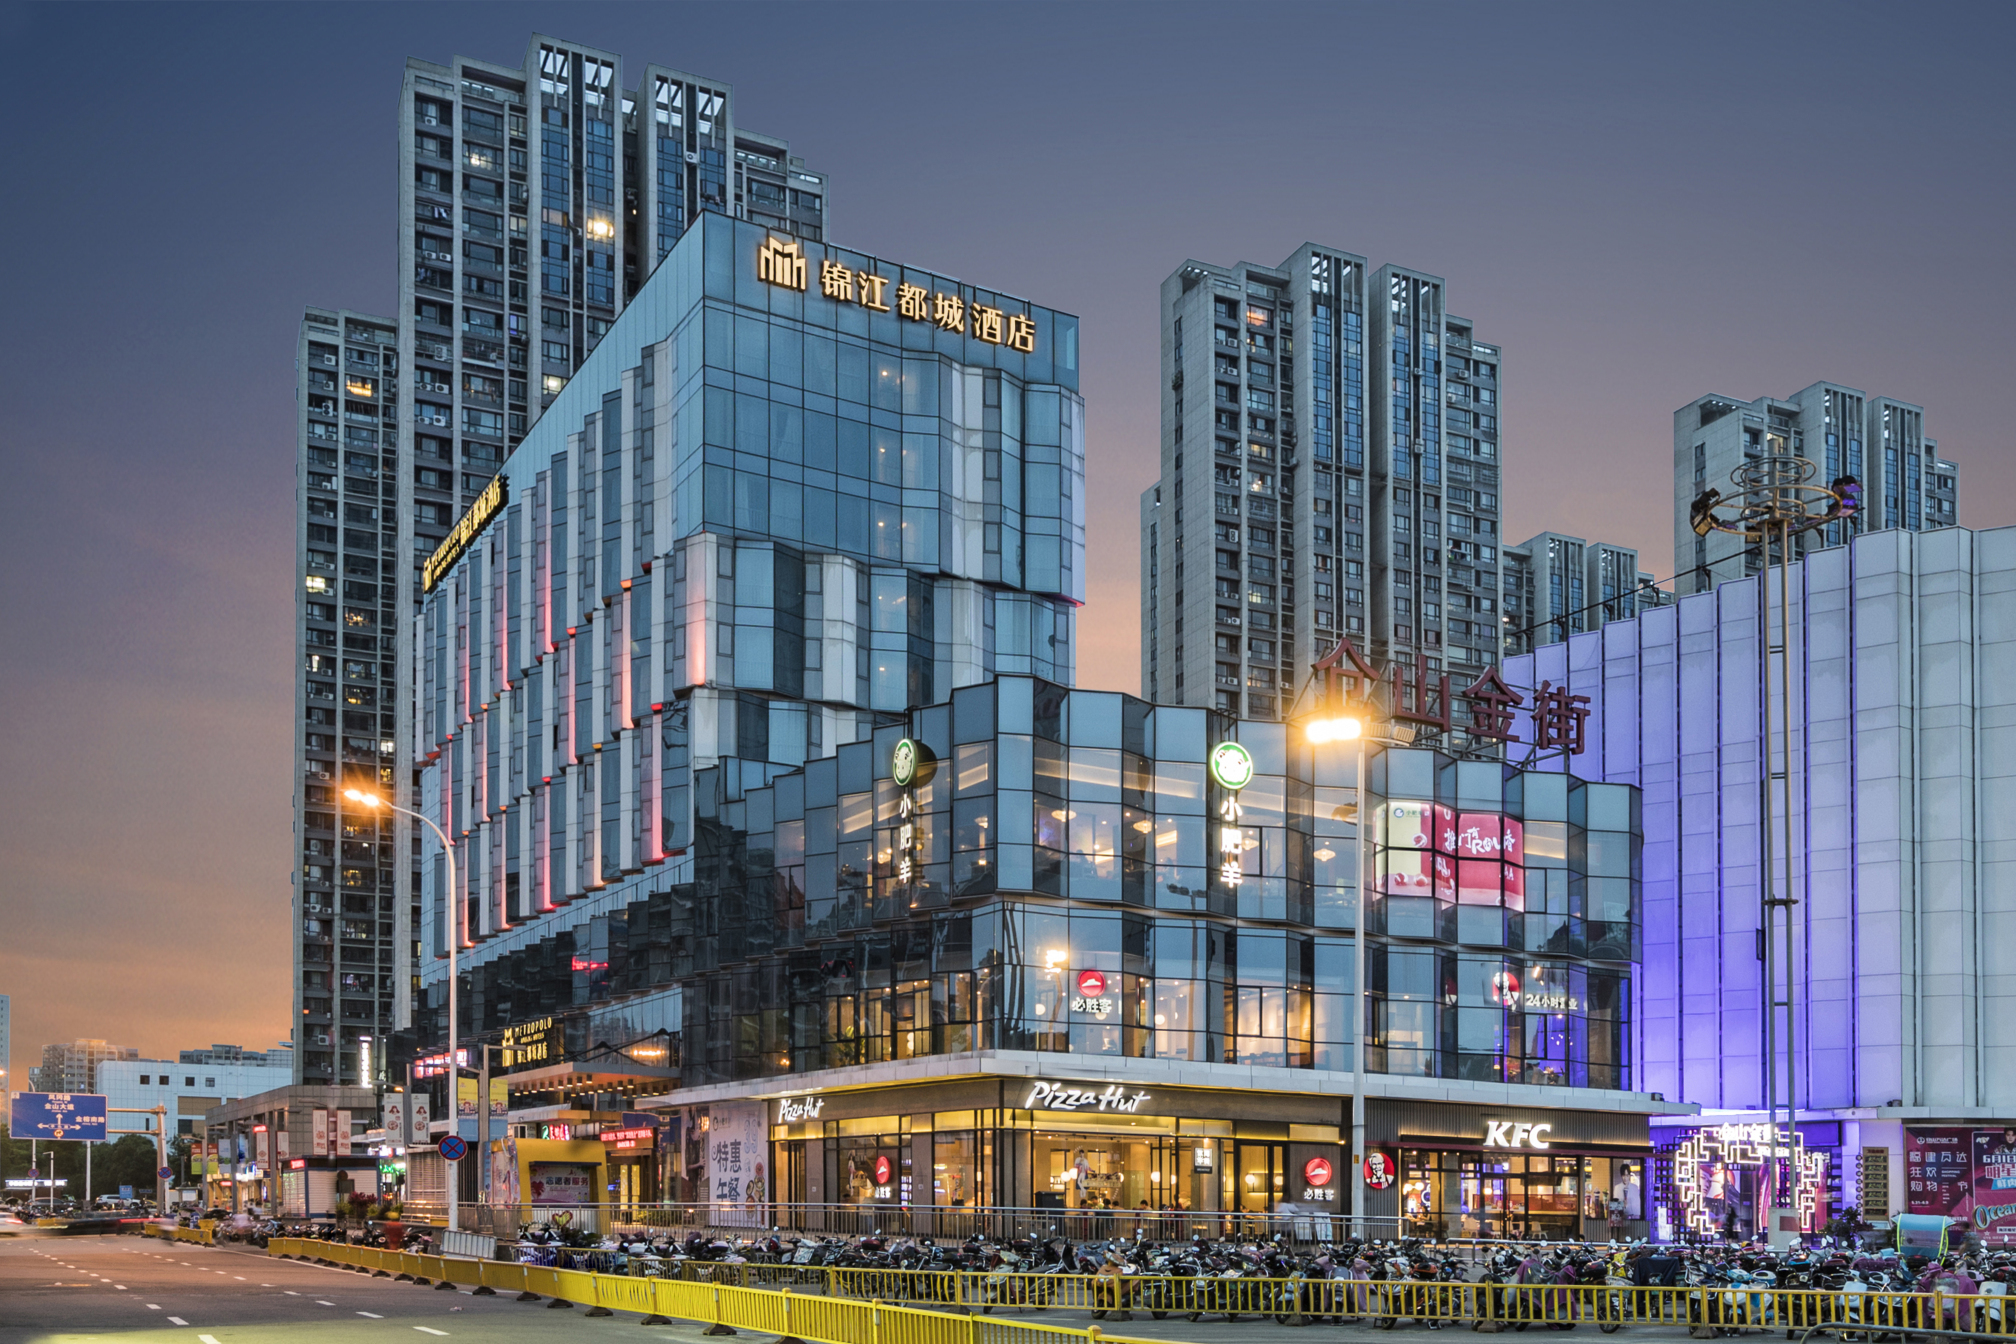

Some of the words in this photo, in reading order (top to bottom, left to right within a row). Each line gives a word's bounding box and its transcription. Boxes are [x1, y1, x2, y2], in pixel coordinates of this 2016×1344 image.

[821, 260, 1036, 353] 锦江都城酒店
[1310, 636, 1591, 755] 仓山金街
[899, 793, 912, 884] 小肥羊
[1220, 796, 1243, 889] 小肥羊
[1071, 996, 1112, 1014] 必胜客
[514, 1016, 552, 1038] METROPOLO
[777, 1098, 804, 1124] Pizza
[803, 1096, 825, 1120] Hut
[1024, 1081, 1097, 1110] Pizza
[1098, 1085, 1152, 1112] Hut
[1483, 1120, 1551, 1149] KFC
[716, 1139, 742, 1173] 特惠
[545, 1176, 589, 1186] 志愿者服务
[1910, 1166, 1937, 1178] 狂欢
[716, 1177, 741, 1209] 午餐
[1303, 1187, 1335, 1201] 必胜客
